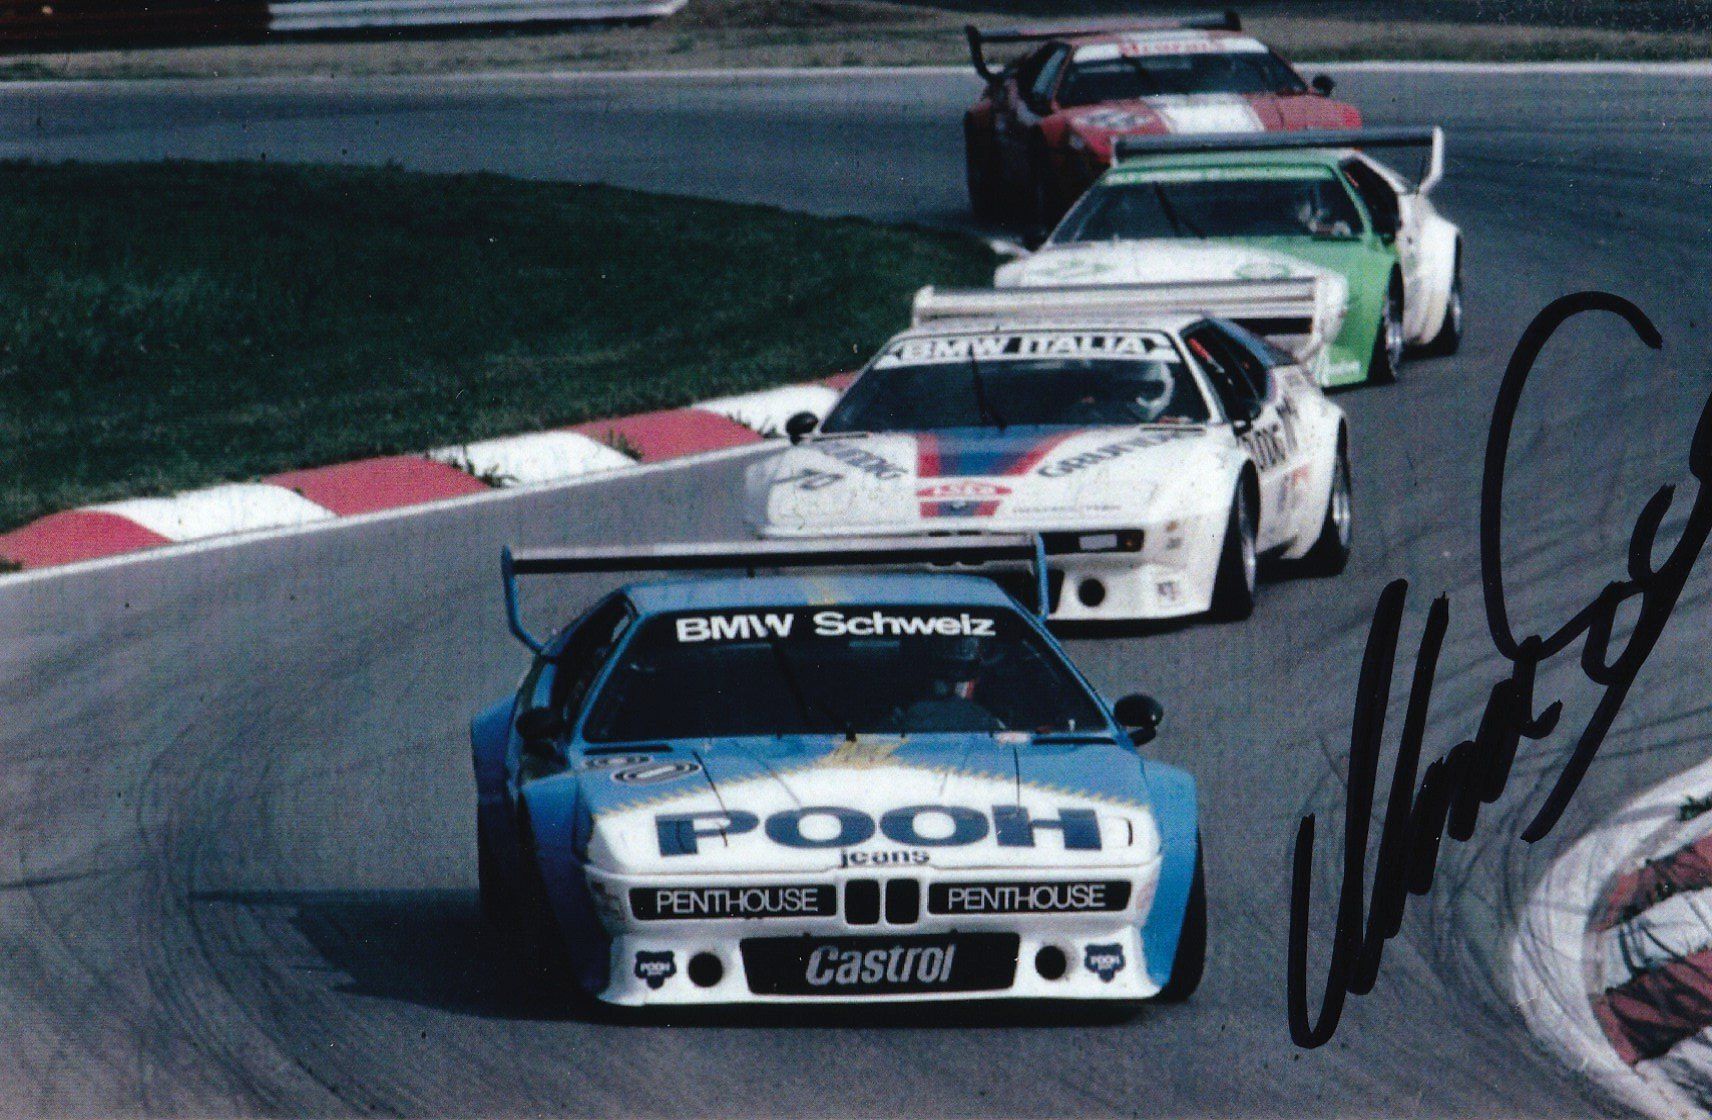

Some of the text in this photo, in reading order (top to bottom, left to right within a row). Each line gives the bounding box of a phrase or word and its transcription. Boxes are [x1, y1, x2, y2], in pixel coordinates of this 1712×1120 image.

[902, 333, 1146, 360] BMW ITALIA
[676, 610, 997, 643] BMW Schweiz
[655, 804, 1103, 857] POOH
[839, 846, 931, 868] jeans
[656, 888, 819, 913] PENTHOUSE
[947, 885, 1107, 911] PENTHOUSE
[805, 944, 957, 987] Castrol
